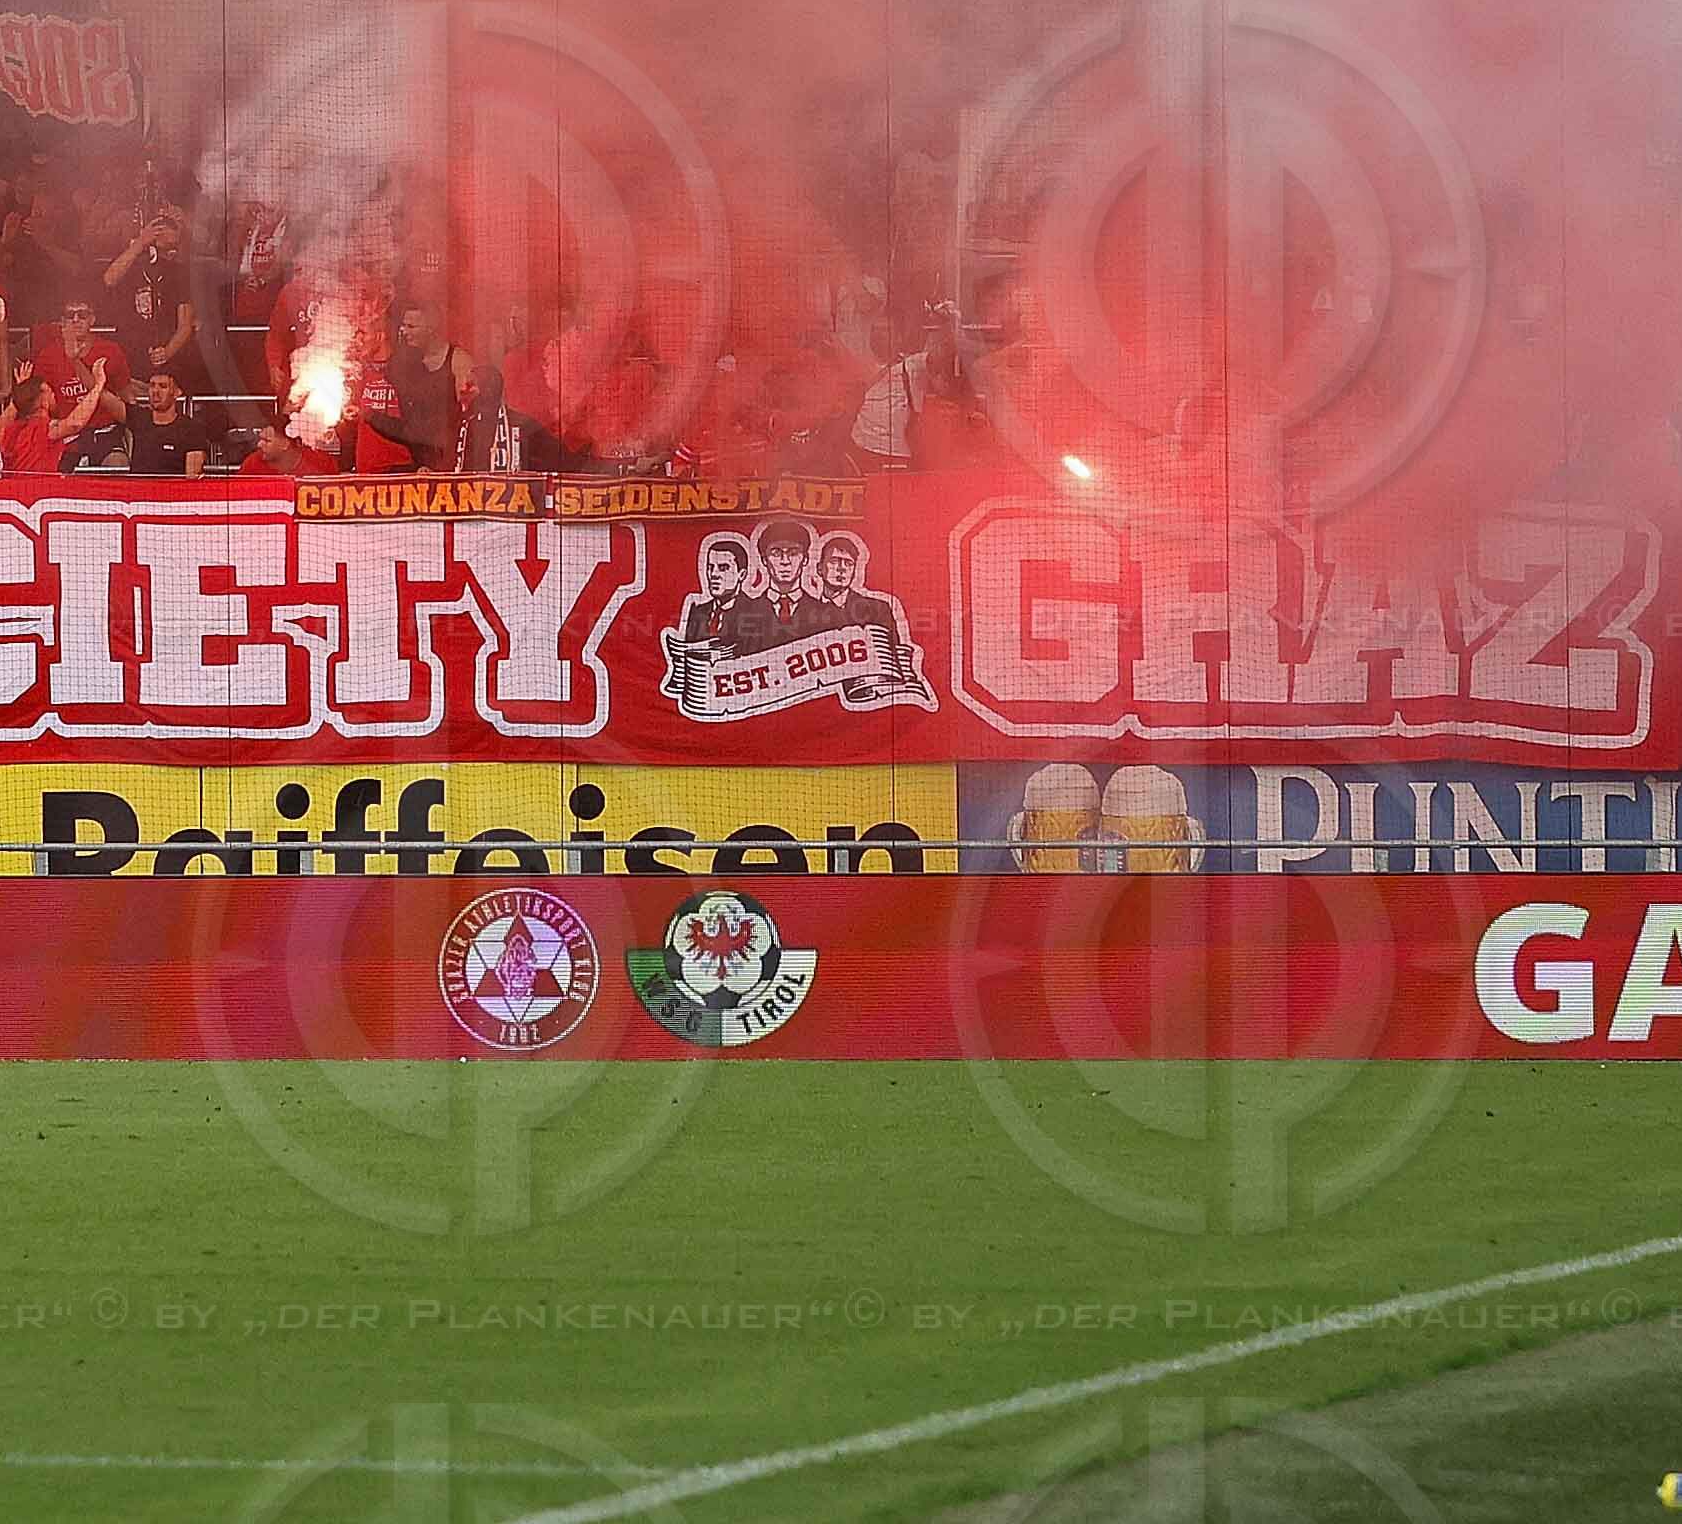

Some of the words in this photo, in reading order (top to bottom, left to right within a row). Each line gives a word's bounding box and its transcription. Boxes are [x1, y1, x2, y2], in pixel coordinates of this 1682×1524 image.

[296, 480, 536, 516] COMUNANZA
[554, 480, 866, 516] SEIDENSTADT
[968, 516, 1620, 712] GRAZ
[713, 666, 781, 698] EST.
[785, 639, 868, 680] 2006
[736, 973, 807, 1036] TIROL
